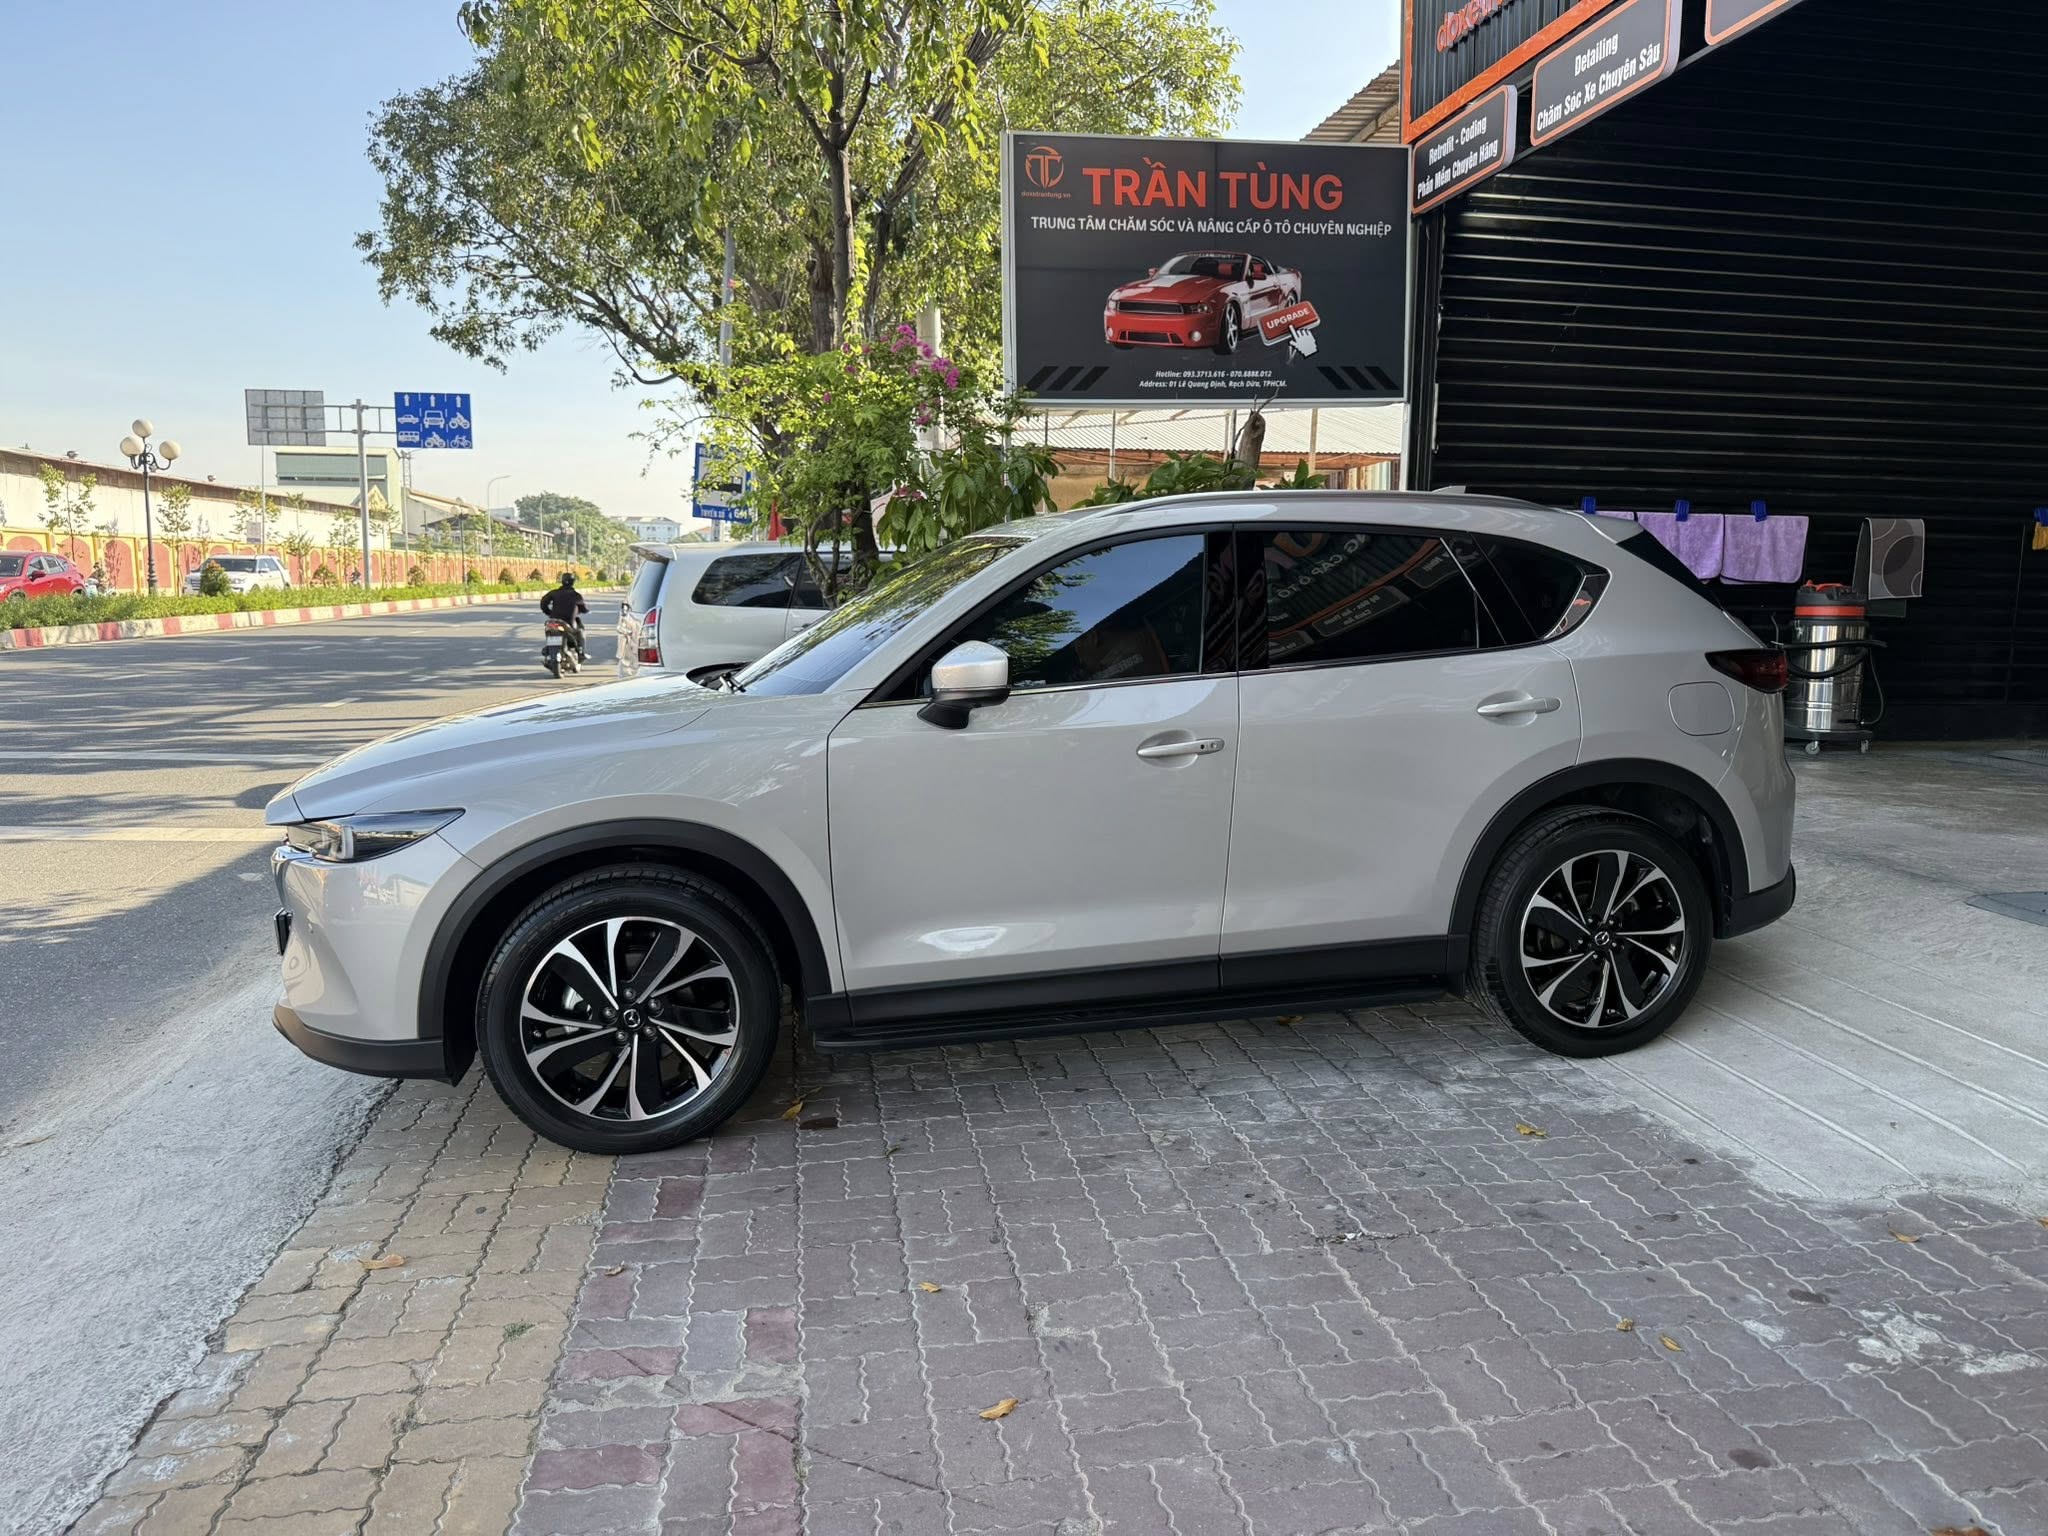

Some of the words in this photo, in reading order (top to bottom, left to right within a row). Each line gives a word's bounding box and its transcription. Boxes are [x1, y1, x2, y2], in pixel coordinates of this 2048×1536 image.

[1574, 33, 1619, 77] Detailing
[1536, 103, 1562, 132] Chăm
[1564, 90, 1582, 116] Sóc
[1583, 81, 1597, 105] Xe
[1598, 57, 1637, 96] Chuyên
[1638, 42, 1661, 72] Sâu
[1428, 135, 1455, 166] Retrofit
[1460, 116, 1487, 146] Coding
[1452, 151, 1478, 179] Chuyên
[1082, 156, 1207, 208] TRẦN
[1219, 161, 1344, 211] TÙNG
[1031, 216, 1076, 230] TRUNG
[1078, 215, 1106, 231] TÂM
[1109, 215, 1147, 232] CHĂM
[1150, 216, 1175, 232] SÓC
[1177, 217, 1195, 233] VÀ
[1197, 218, 1234, 233] NÂNG
[1236, 218, 1261, 234] CẤP
[1263, 219, 1273, 234] Ô
[1274, 220, 1291, 235] TÔ
[1293, 220, 1344, 236] CHUYÊN
[1346, 221, 1392, 239] NGHIỆP
[1266, 307, 1311, 329] UPGRADE
[1139, 380, 1168, 388] Address:
[1178, 380, 1187, 388] Lê
[1188, 380, 1209, 390] Quang
[1155, 370, 1182, 378] Hotline:
